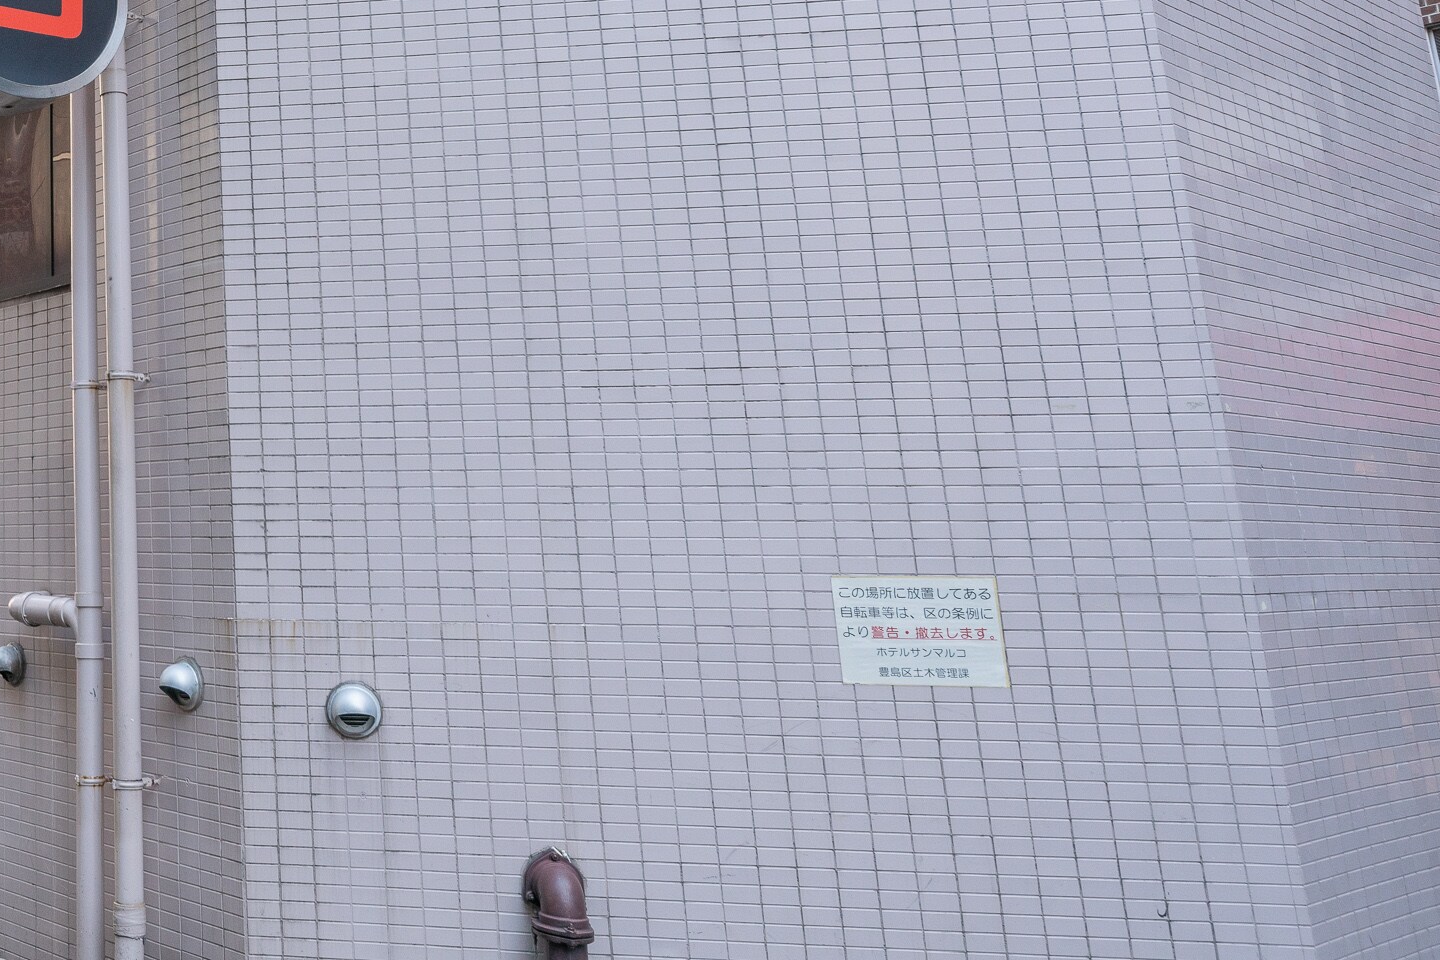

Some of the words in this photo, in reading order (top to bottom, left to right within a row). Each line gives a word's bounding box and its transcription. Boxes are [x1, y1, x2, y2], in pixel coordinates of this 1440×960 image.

[838, 587, 991, 601] この場所に放置してある
[840, 607, 994, 620] 自転車等は、区の条例に
[842, 625, 996, 640] より警告・撤去します。
[876, 647, 967, 659] ホテルサンマルコ
[878, 667, 970, 679] 豊島区土木管理課
